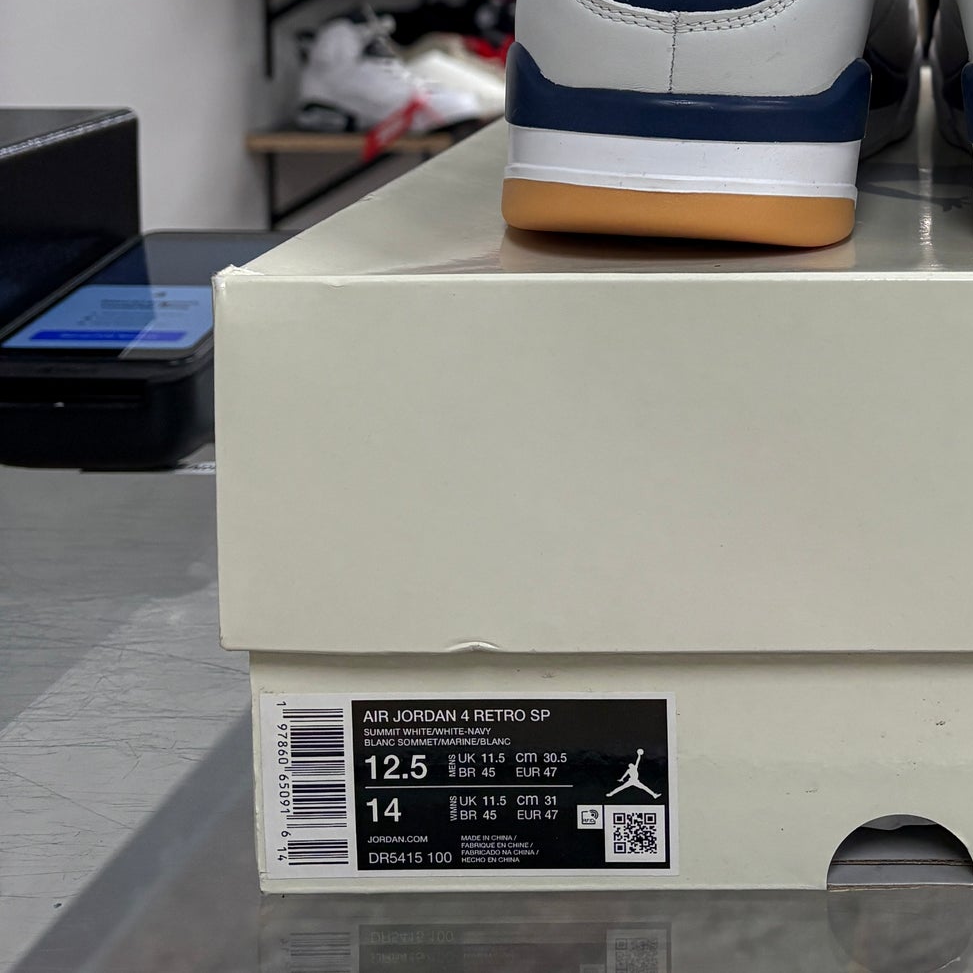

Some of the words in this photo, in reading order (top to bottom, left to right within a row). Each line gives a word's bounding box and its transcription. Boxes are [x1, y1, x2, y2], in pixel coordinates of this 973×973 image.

[363, 710, 389, 723] AIR
[393, 709, 457, 723] JORDAN
[460, 710, 470, 722] 4
[474, 709, 526, 722] RETRO
[530, 708, 551, 722] SP
[363, 728, 400, 737] SUMMIT
[403, 727, 491, 736] WHITE/WHITE-NAVY
[277, 723, 289, 765] 97860
[364, 738, 395, 747] BLANC
[398, 737, 511, 746] SOMMET/MARINE/BLANC
[458, 753, 476, 764] UK
[481, 752, 506, 763] 11.5
[543, 752, 567, 763] 30.5
[364, 754, 428, 780] 12.5
[448, 754, 457, 777] MENS
[458, 767, 476, 777] BR
[481, 767, 496, 777] 45
[516, 767, 541, 777] EUR
[543, 767, 558, 777] 47
[279, 774, 291, 814] 65091
[459, 796, 477, 806] UK
[482, 795, 507, 806] 11.5
[544, 795, 557, 806] 31
[366, 797, 402, 822] 14
[450, 795, 458, 821] WMNS
[460, 810, 477, 820] BR
[482, 810, 497, 820] 45
[517, 810, 542, 820] EUR
[544, 810, 559, 820] 47
[367, 835, 428, 843] JORDAN.COM
[368, 852, 423, 864] DR5415
[427, 851, 453, 864] 100
